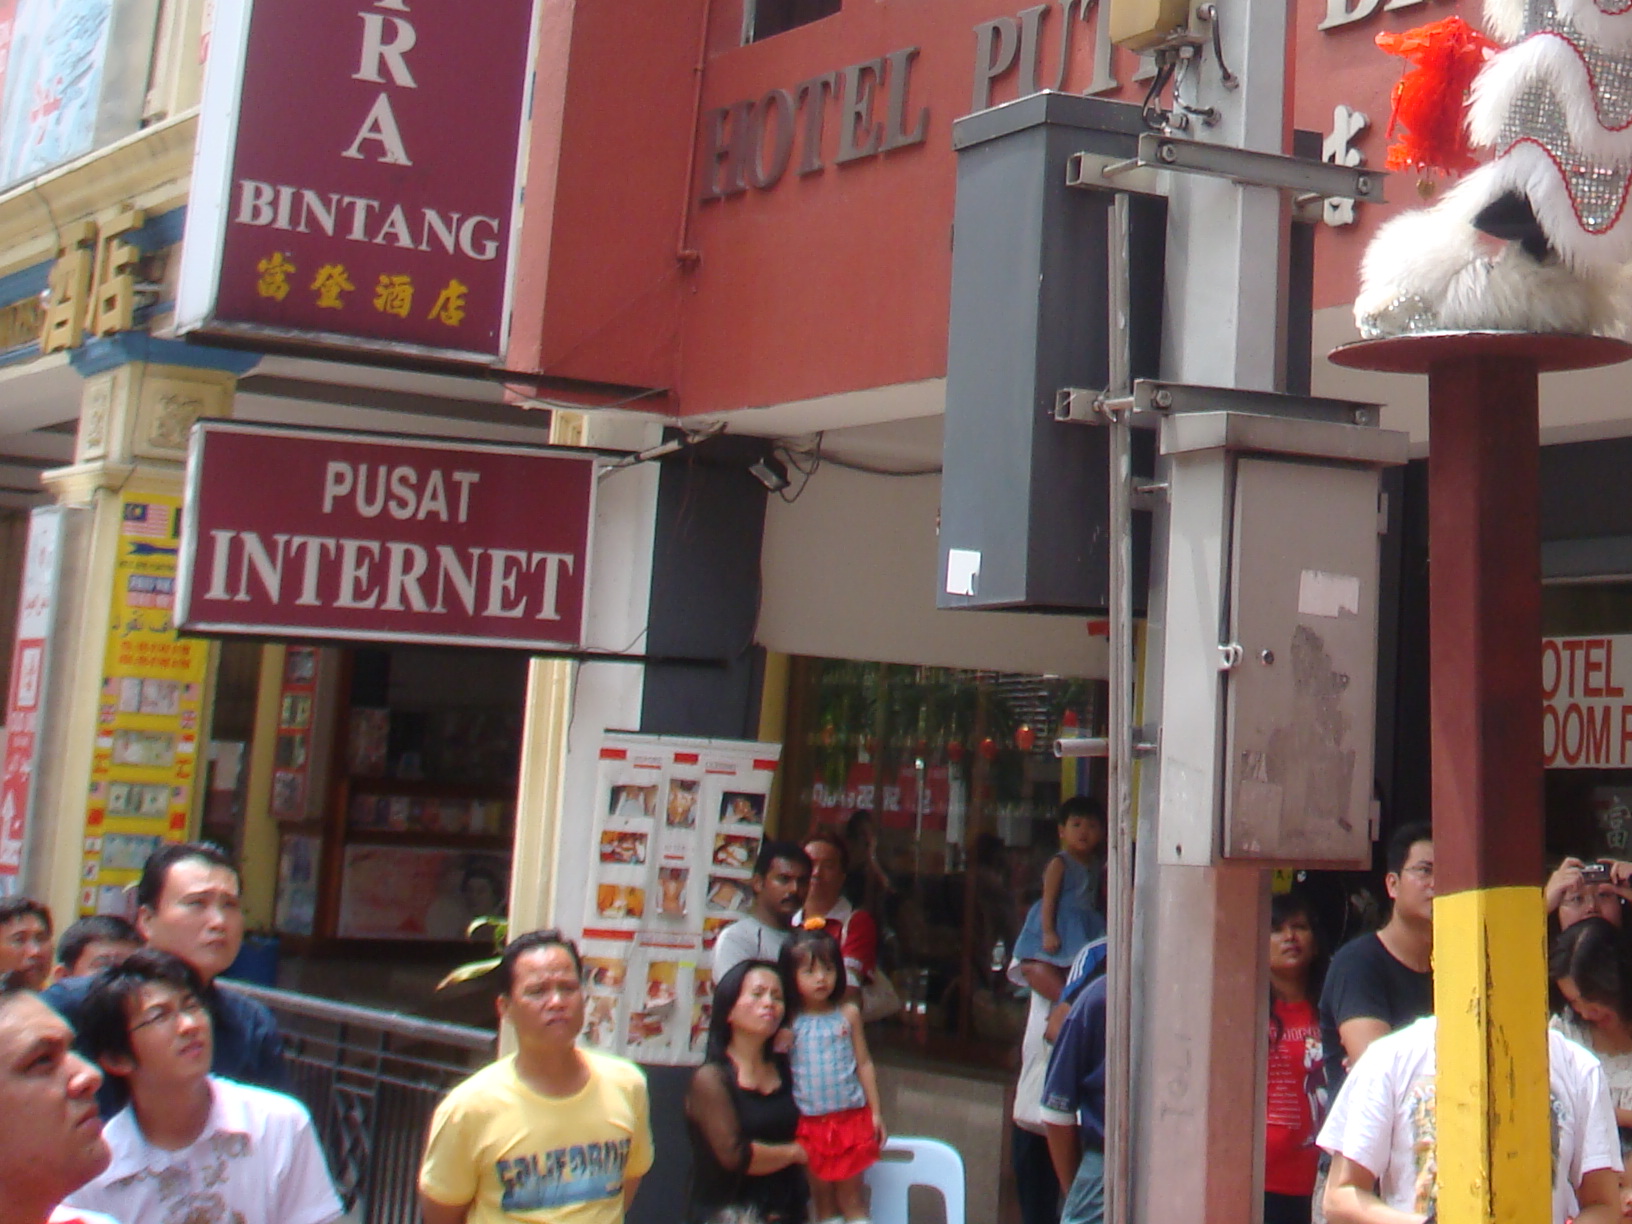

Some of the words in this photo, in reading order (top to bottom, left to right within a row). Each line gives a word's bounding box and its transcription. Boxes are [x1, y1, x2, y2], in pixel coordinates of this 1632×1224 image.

[699, 46, 930, 204] HOTEL
[236, 179, 501, 262] BINTANG
[255, 251, 471, 328] 富登酒店
[321, 460, 480, 524] PUSAT
[202, 528, 574, 621] INTERNET
[1542, 638, 1624, 699] OTEL
[1543, 704, 1611, 766] OOM
